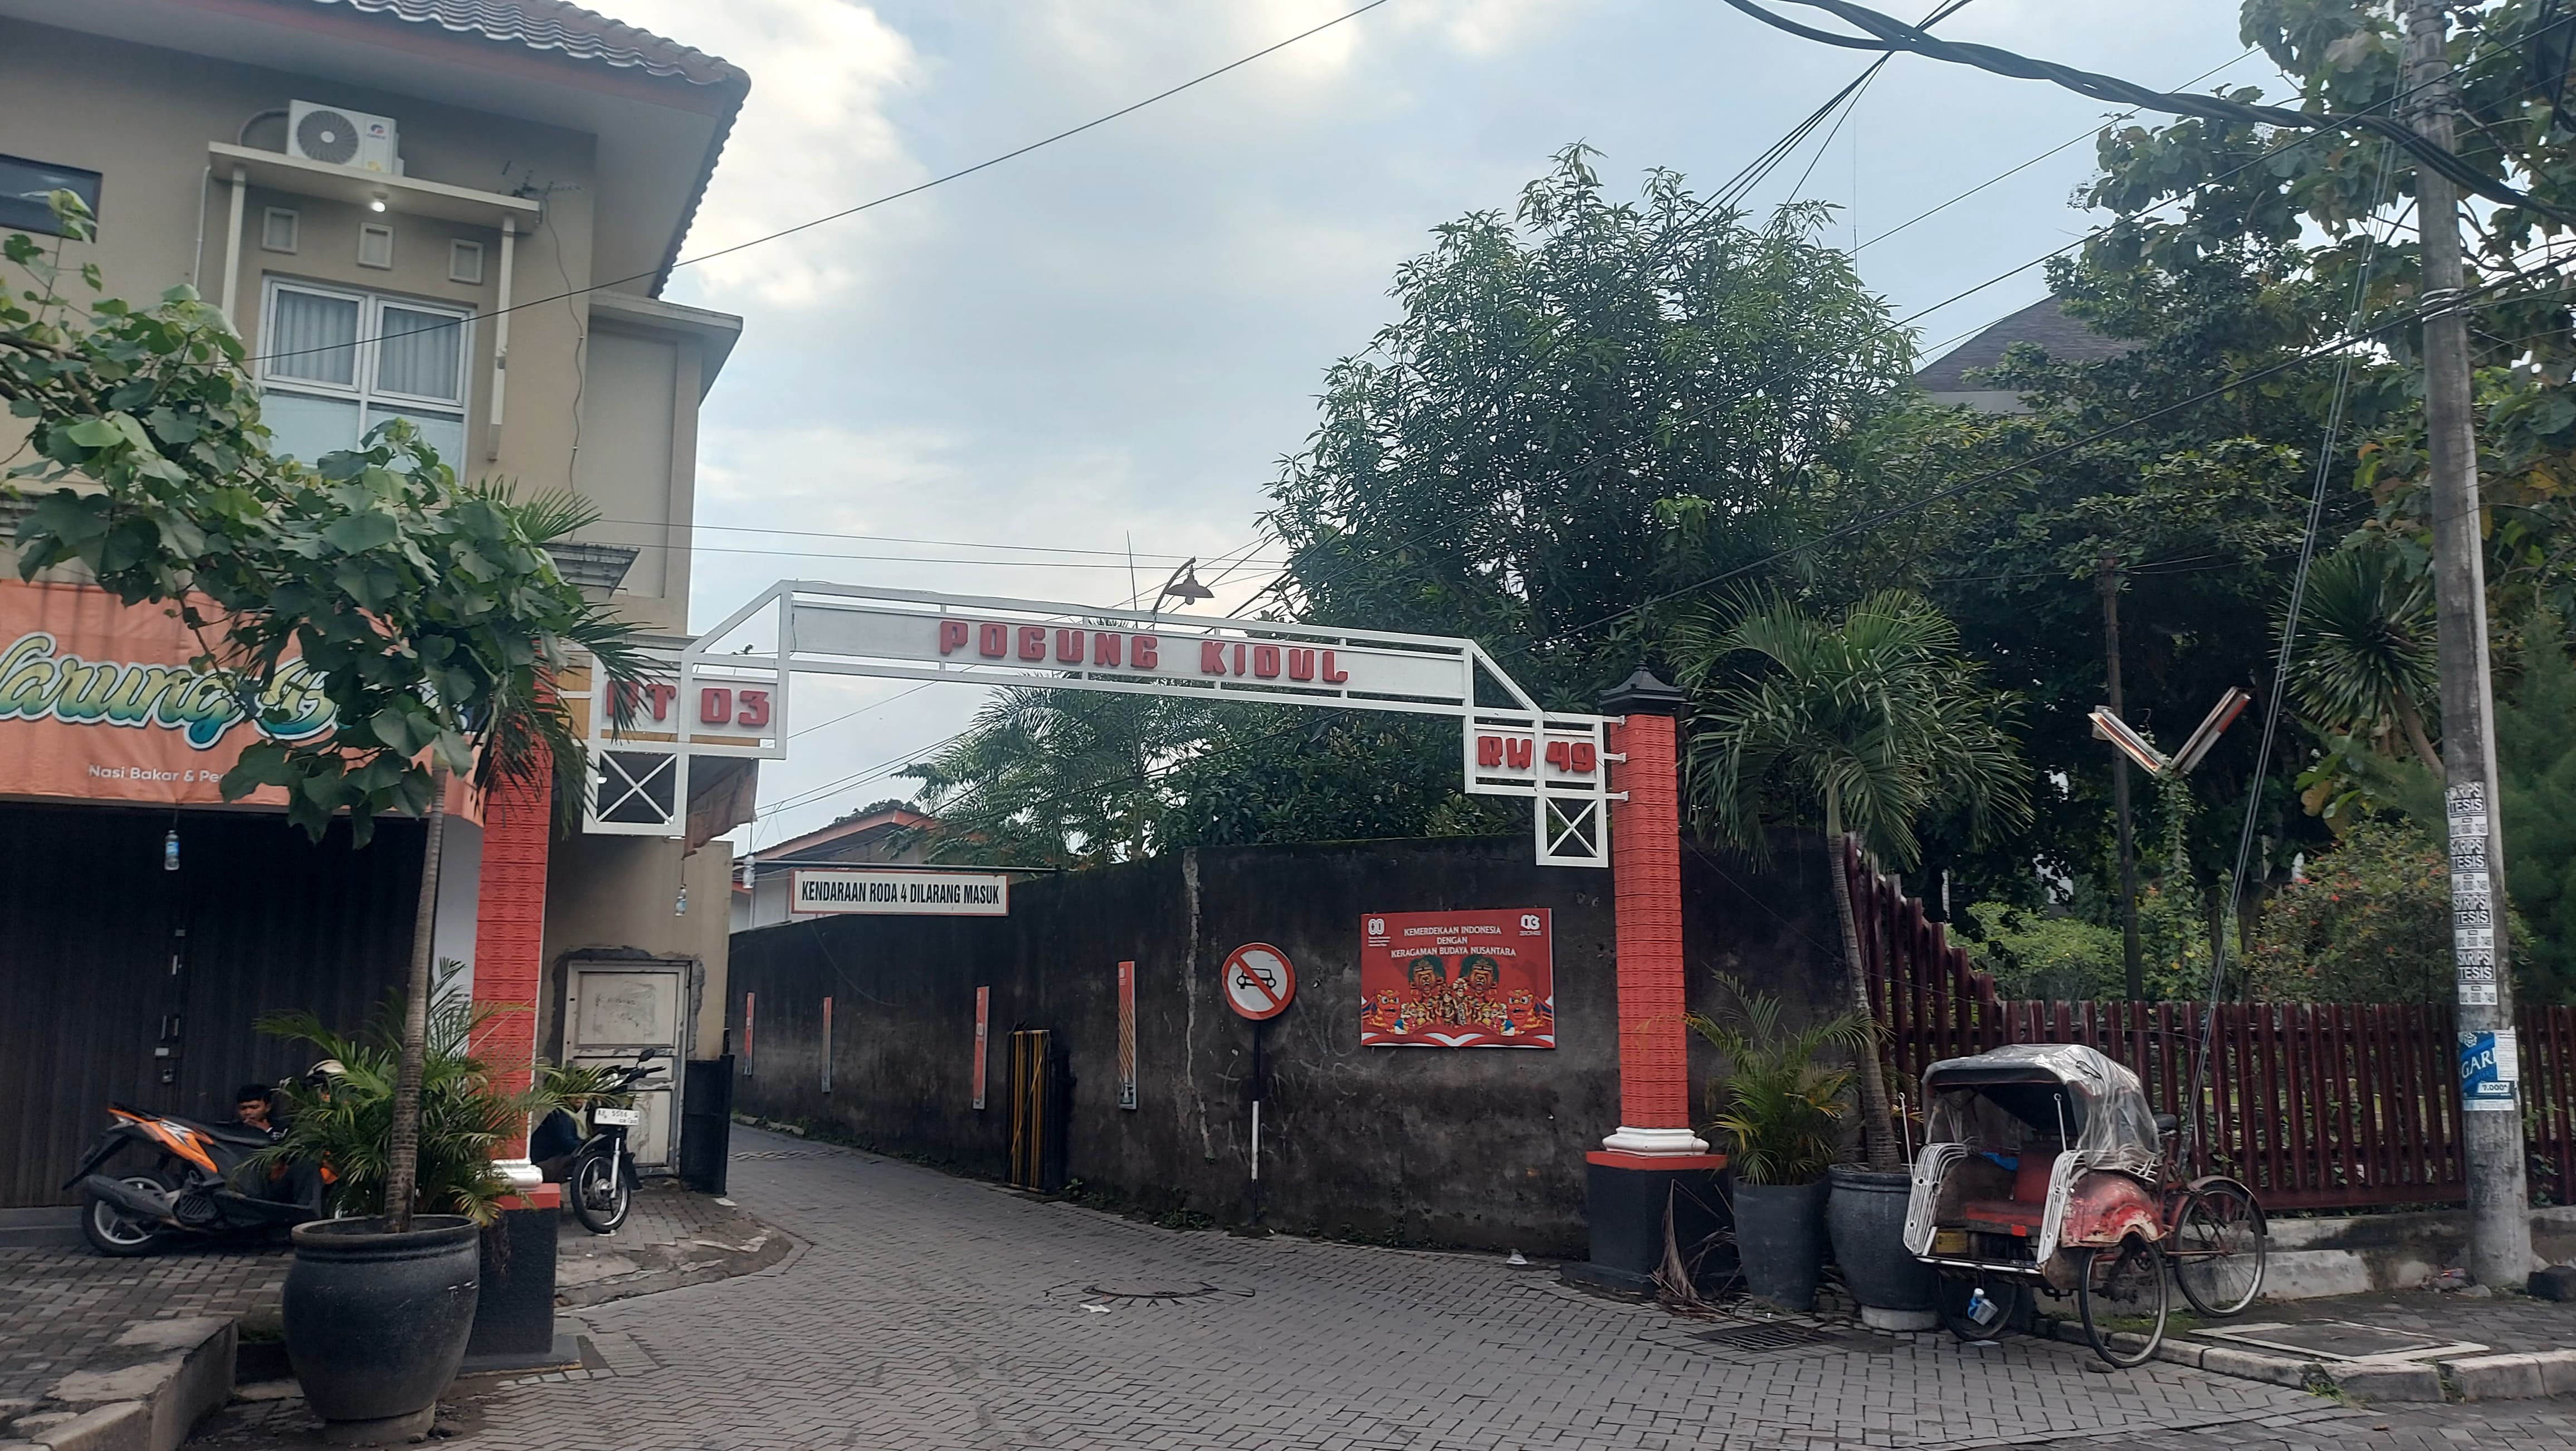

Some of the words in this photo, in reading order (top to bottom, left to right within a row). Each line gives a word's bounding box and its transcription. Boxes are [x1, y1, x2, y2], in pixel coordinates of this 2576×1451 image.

[939, 620, 1159, 669] POGUNG
[1201, 641, 1349, 683] KIDUL
[700, 688, 770, 726] 03
[1477, 736, 1533, 768] RW
[1545, 741, 1597, 772] 49
[89, 765, 125, 778] Nasi
[130, 767, 179, 781] Bakar
[183, 770, 194, 782] &
[2450, 799, 2483, 812] TESIS
[2451, 855, 2485, 868] TESIS
[802, 881, 866, 902] KENDARAAN
[870, 883, 898, 903] RODA
[900, 883, 907, 903] 4
[910, 884, 960, 904] DILARANG
[963, 885, 999, 905] MASUK
[2454, 910, 2489, 924] TESIS
[1404, 926, 1459, 937] KEMERDEKAAN
[1461, 926, 1502, 934] INDONESIA
[1437, 936, 1468, 944] DENGAN
[1391, 947, 1437, 958] KERAGAMAN
[1440, 947, 1468, 955] BUDAYA
[1470, 947, 1517, 957] NUSANTARA
[2457, 966, 2493, 979] TESIS
